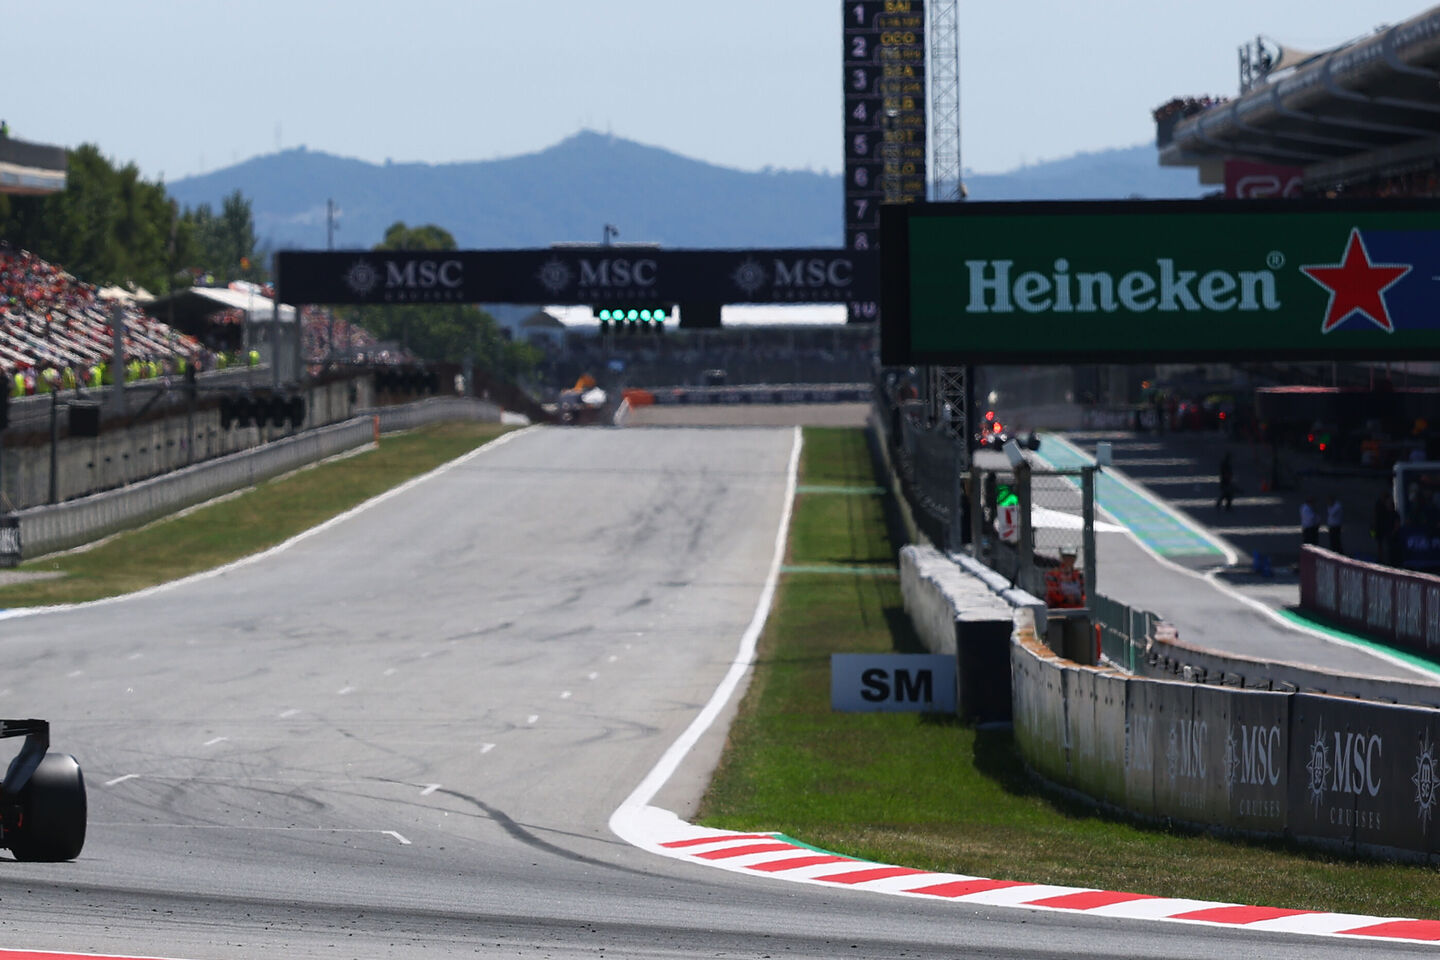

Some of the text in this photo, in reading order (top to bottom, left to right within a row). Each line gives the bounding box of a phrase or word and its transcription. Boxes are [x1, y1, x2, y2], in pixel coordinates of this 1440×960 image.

[853, 3, 865, 24] 1
[852, 36, 867, 57] 2
[853, 68, 867, 90] 3
[853, 102, 867, 121] 4
[854, 199, 869, 219] 7
[384, 259, 463, 288] MSC
[578, 258, 657, 288] MSC
[773, 258, 853, 288] MSC
[964, 257, 1282, 313] Heineken
[861, 668, 933, 702] SM
[1180, 719, 1208, 778] MSC
[1240, 724, 1281, 786] MSC
[1331, 730, 1382, 797] MSC
[1239, 799, 1281, 817] CRUISES
[1330, 807, 1382, 830] CRUISES
